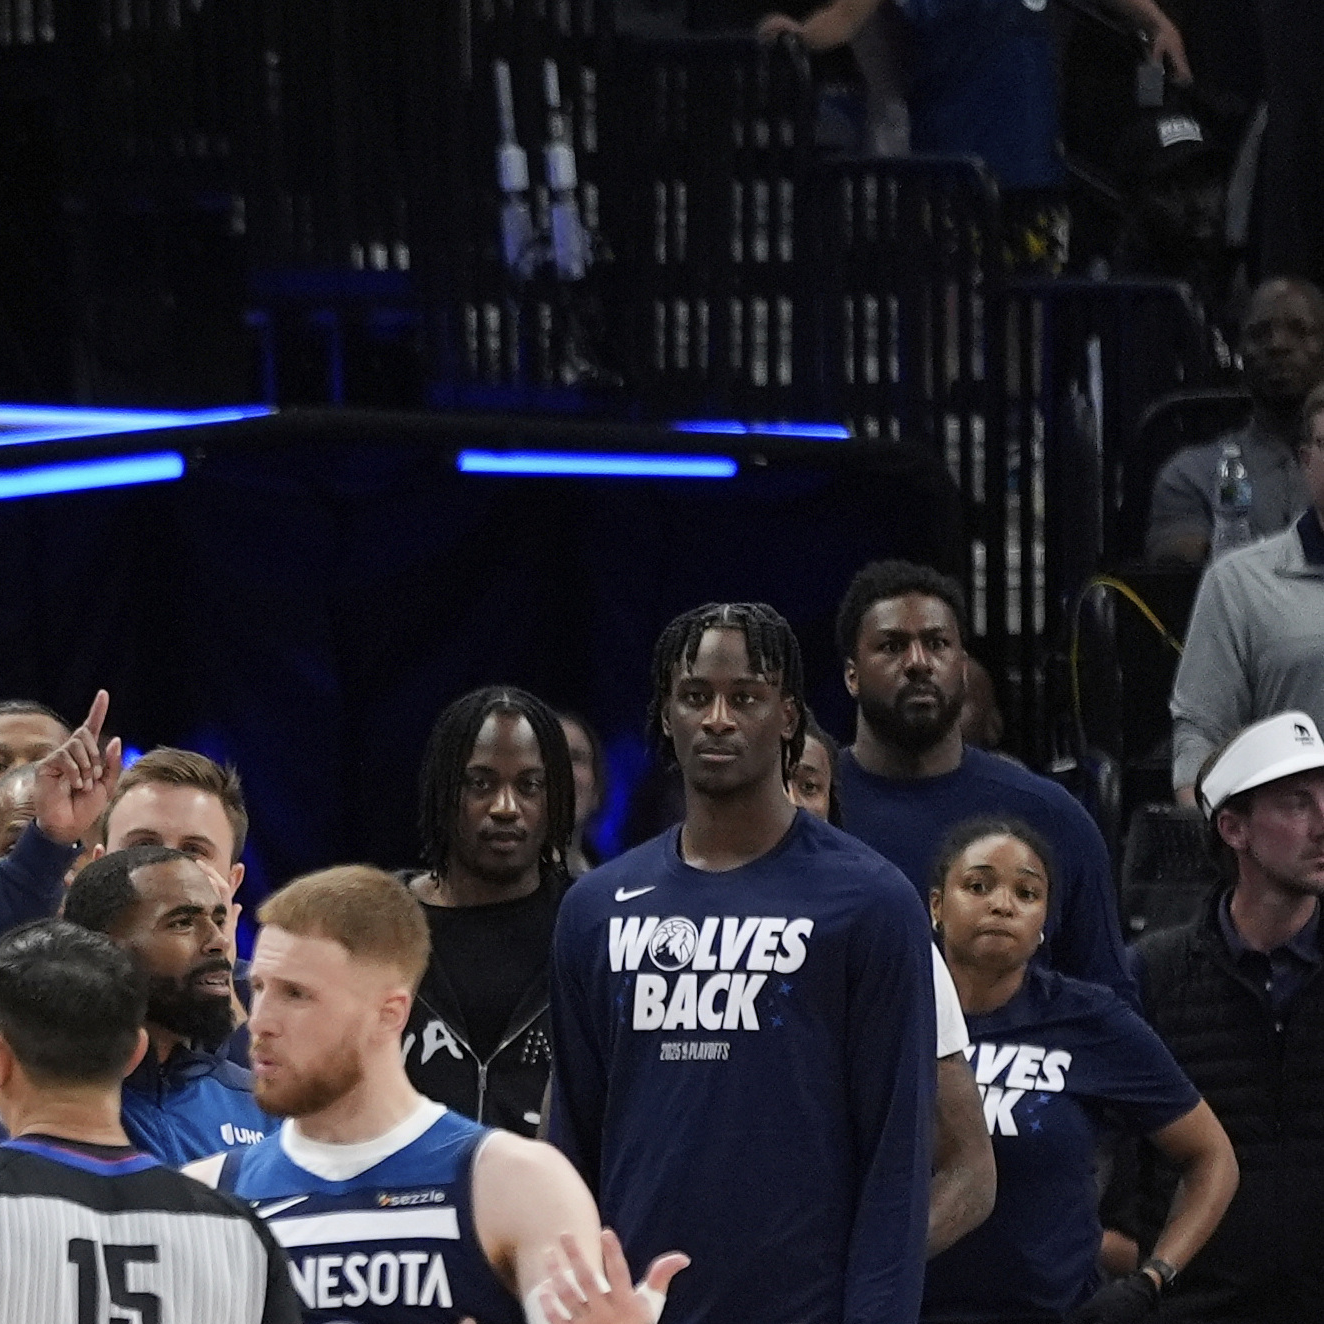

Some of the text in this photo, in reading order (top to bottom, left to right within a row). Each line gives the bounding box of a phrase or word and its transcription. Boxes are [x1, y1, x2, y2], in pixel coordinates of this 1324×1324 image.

[608, 916, 815, 974] WOLVES
[632, 973, 769, 1031] BACK
[660, 1042, 731, 1061] 2025 PLAYOFFS
[962, 1043, 1073, 1092] VES
[390, 1190, 446, 1206] sezzle
[287, 1252, 453, 1309] NESOTA
